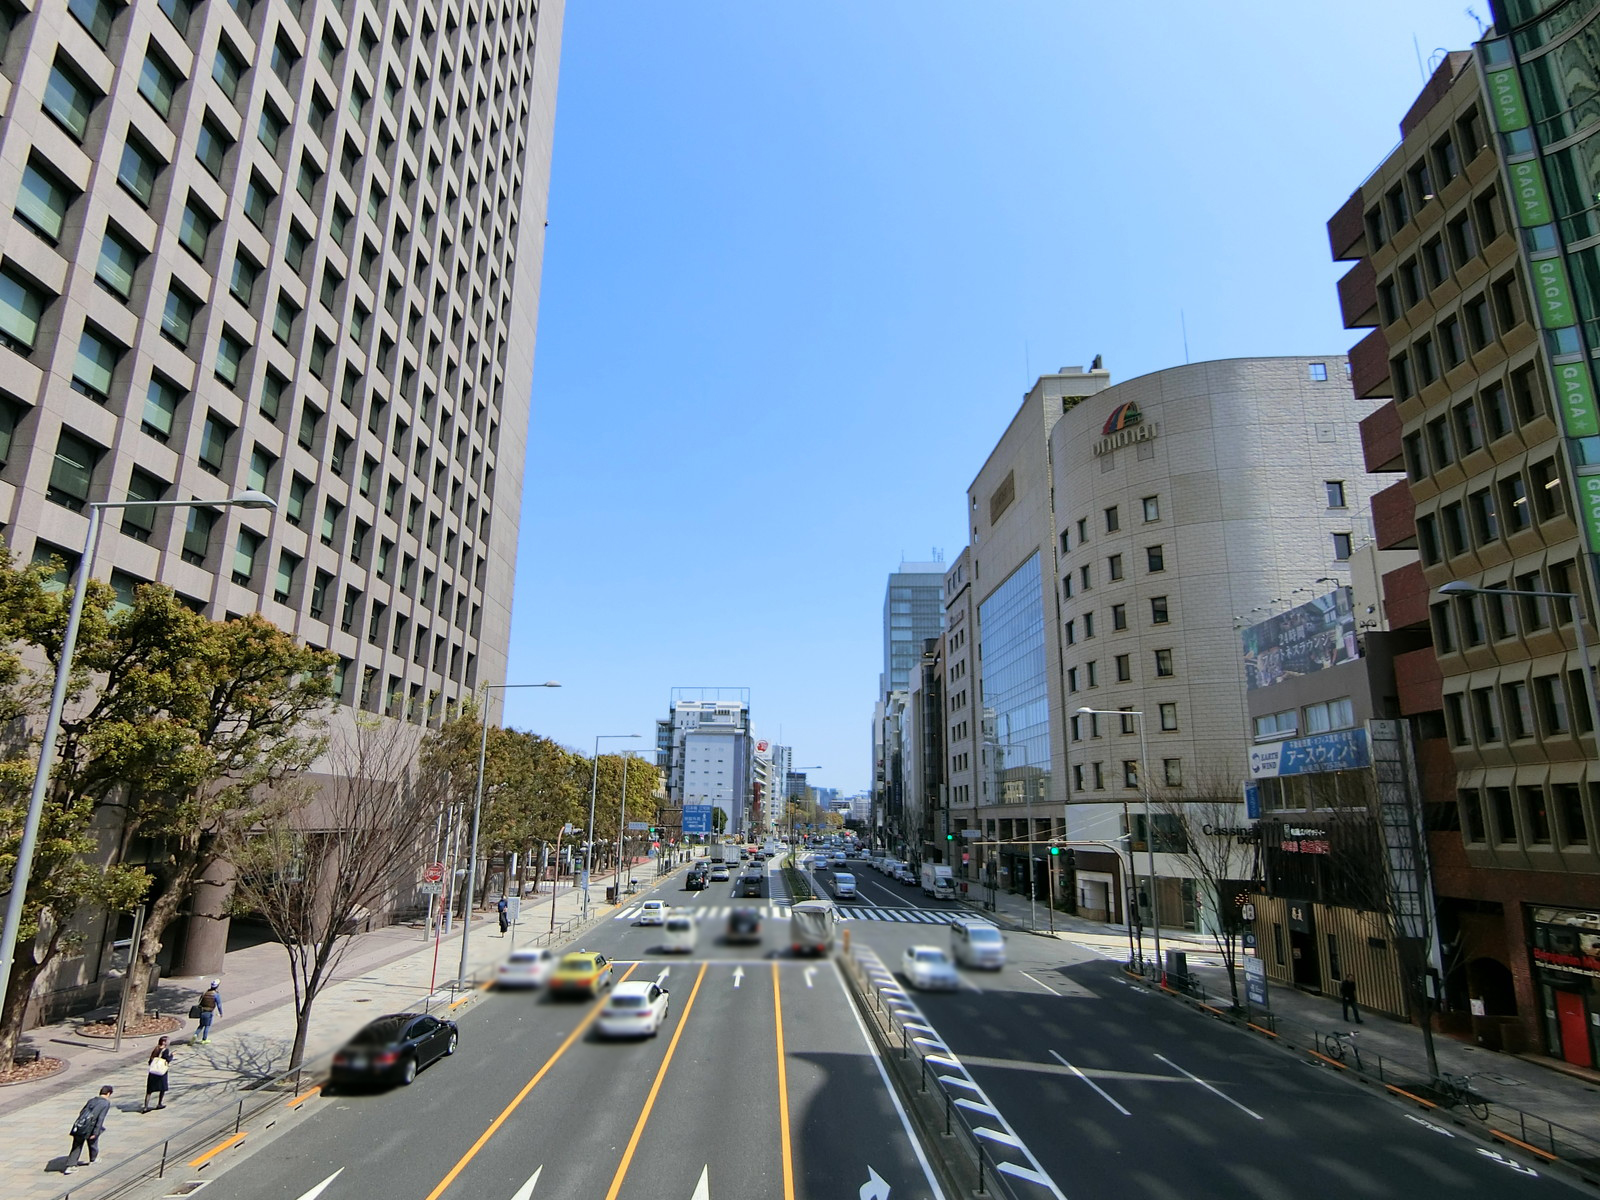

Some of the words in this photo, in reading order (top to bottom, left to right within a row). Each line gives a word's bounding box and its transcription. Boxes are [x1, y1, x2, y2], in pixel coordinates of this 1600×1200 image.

[1495, 73, 1517, 118] GAGA
[1517, 165, 1539, 211] GAGA
[1539, 262, 1563, 311] GAGA
[1563, 367, 1587, 418] GAGA
[1261, 751, 1279, 762] EARTH
[1261, 761, 1277, 770] WIND
[1202, 823, 1254, 837] Cassina
